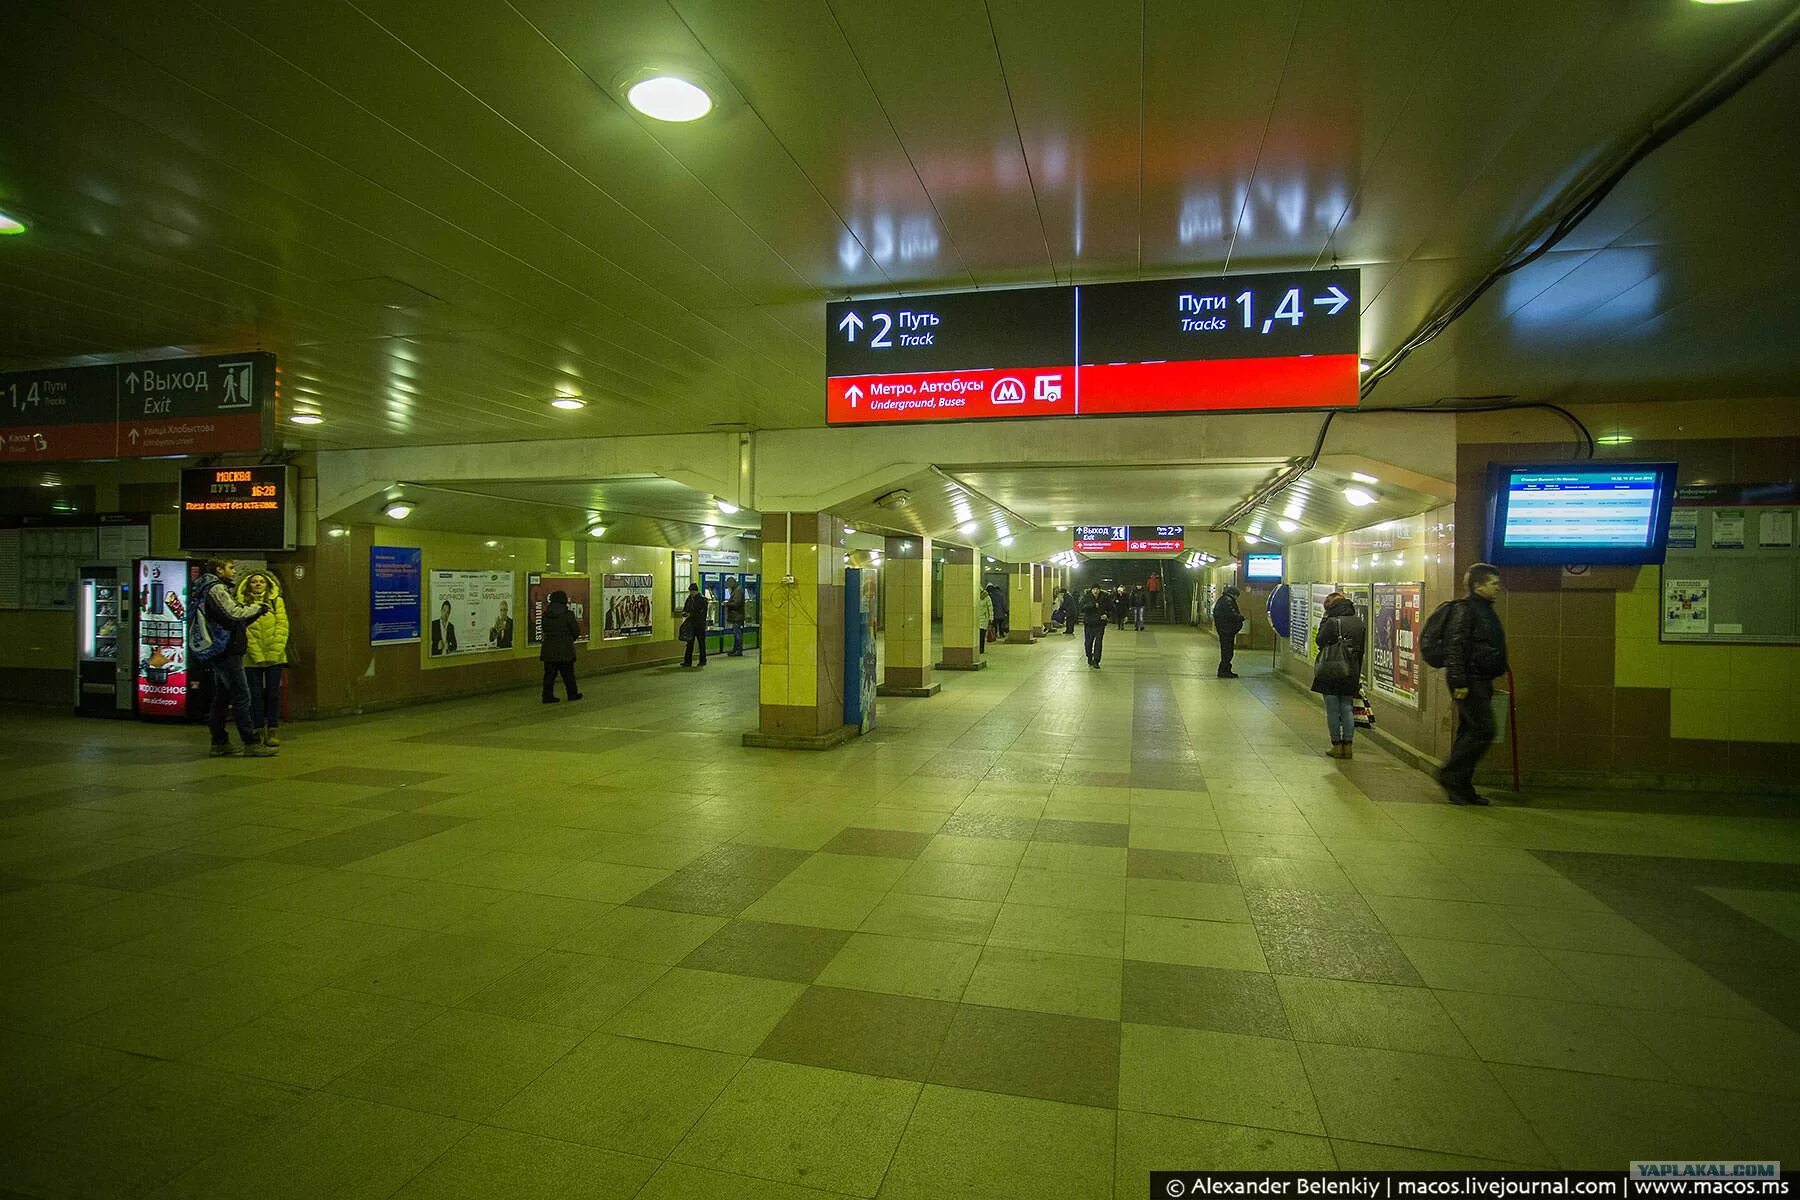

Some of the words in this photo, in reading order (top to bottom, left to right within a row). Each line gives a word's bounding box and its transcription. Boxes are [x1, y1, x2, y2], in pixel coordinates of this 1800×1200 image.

[1179, 295, 1226, 314] Пути
[1236, 289, 1304, 334] 1,4
[871, 314, 893, 348] 2
[899, 312, 940, 331] Путь
[1181, 317, 1226, 332] Tracks
[900, 333, 934, 347] Track
[143, 370, 209, 393] Выход
[870, 384, 917, 397] Метро,
[919, 379, 984, 394] Автобусы
[9, 382, 40, 412] 1,4
[144, 397, 172, 414] Exit
[870, 399, 936, 411] Underground,
[938, 397, 966, 407] Buses
[216, 472, 252, 482] МОСКВА
[535, 601, 543, 641] STADIUM
